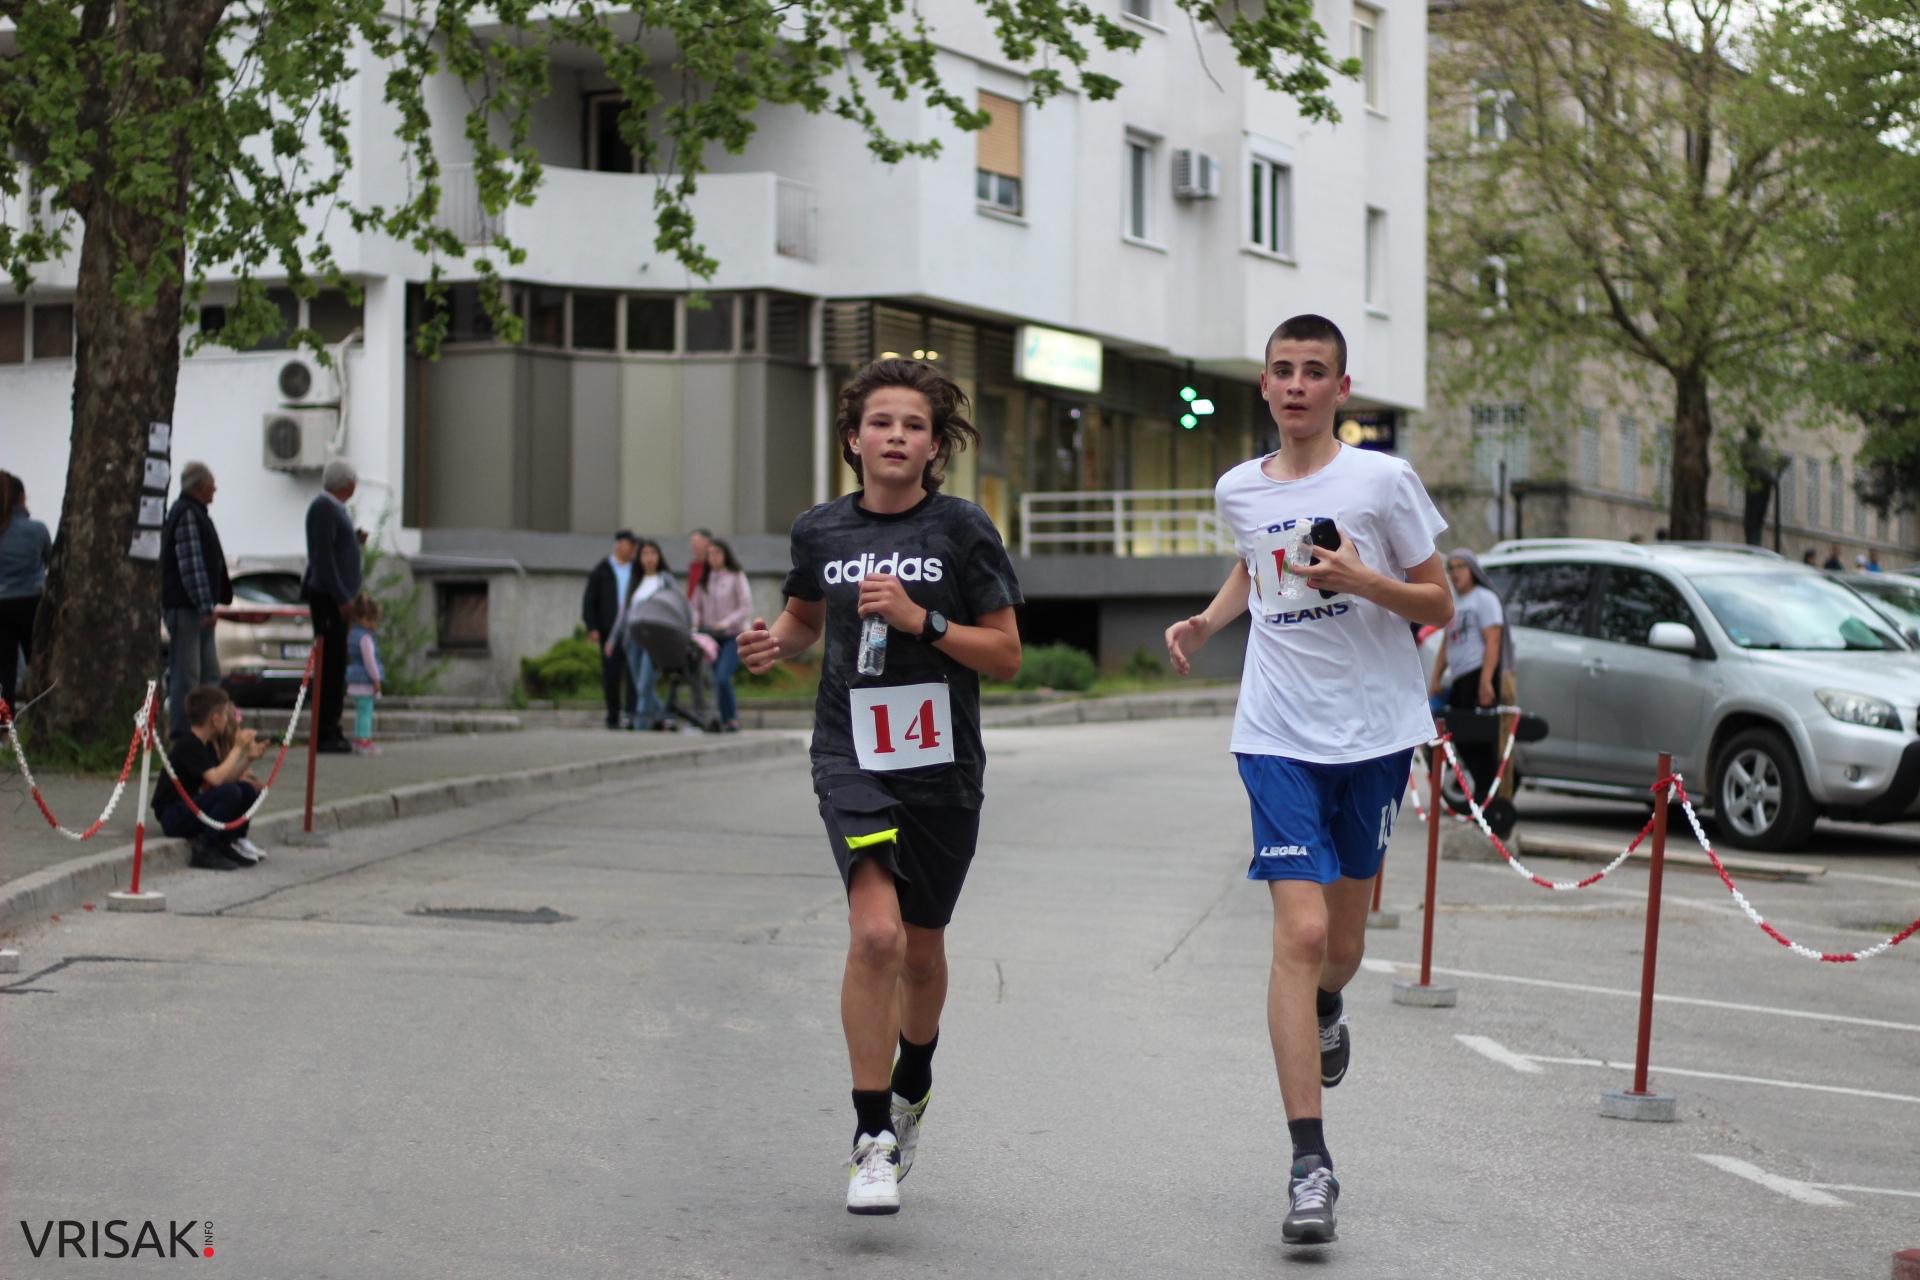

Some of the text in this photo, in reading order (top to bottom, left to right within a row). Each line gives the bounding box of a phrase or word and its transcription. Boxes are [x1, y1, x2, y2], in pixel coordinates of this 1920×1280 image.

[823, 552, 943, 585] adidas
[1271, 602, 1349, 624] JEANS
[870, 699, 941, 753] 14
[1259, 845, 1308, 857] LEGEA
